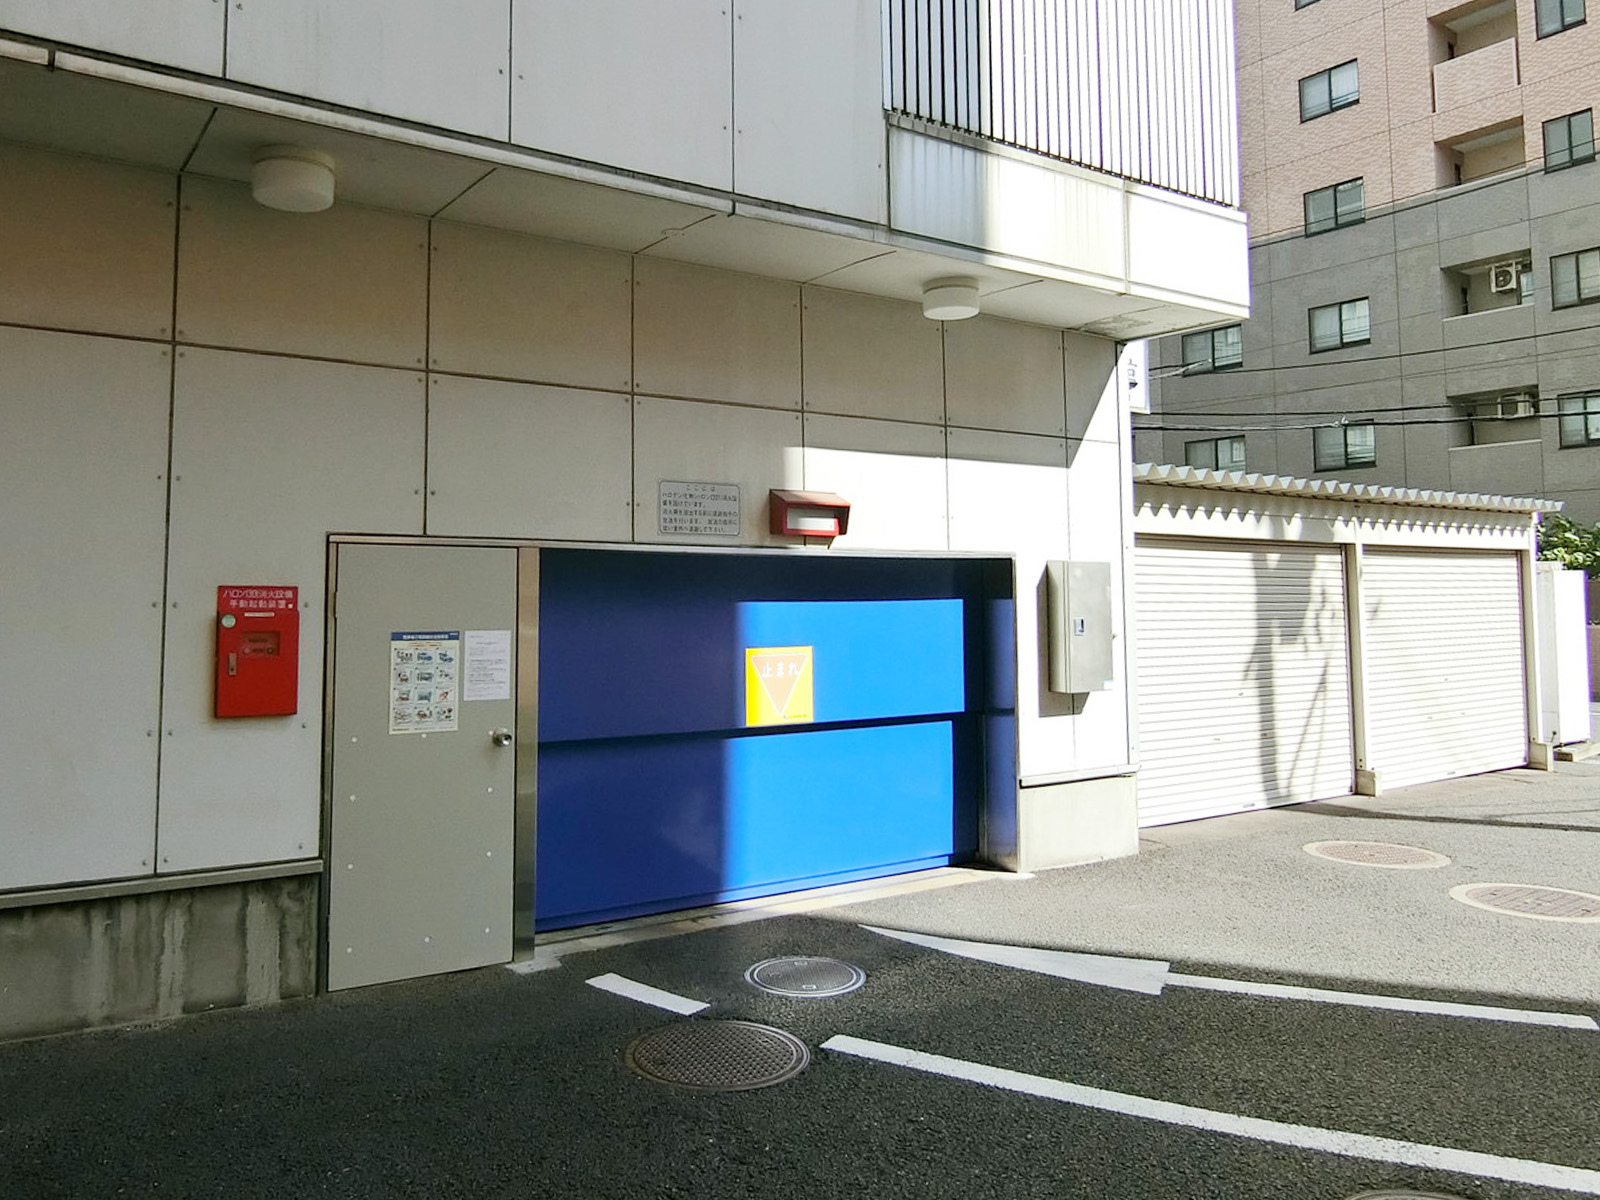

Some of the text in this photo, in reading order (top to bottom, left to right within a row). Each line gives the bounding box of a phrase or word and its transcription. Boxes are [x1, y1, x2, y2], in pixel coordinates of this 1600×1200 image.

[230, 600, 286, 608] 手動起動装置
[762, 661, 800, 678] 止まれ
